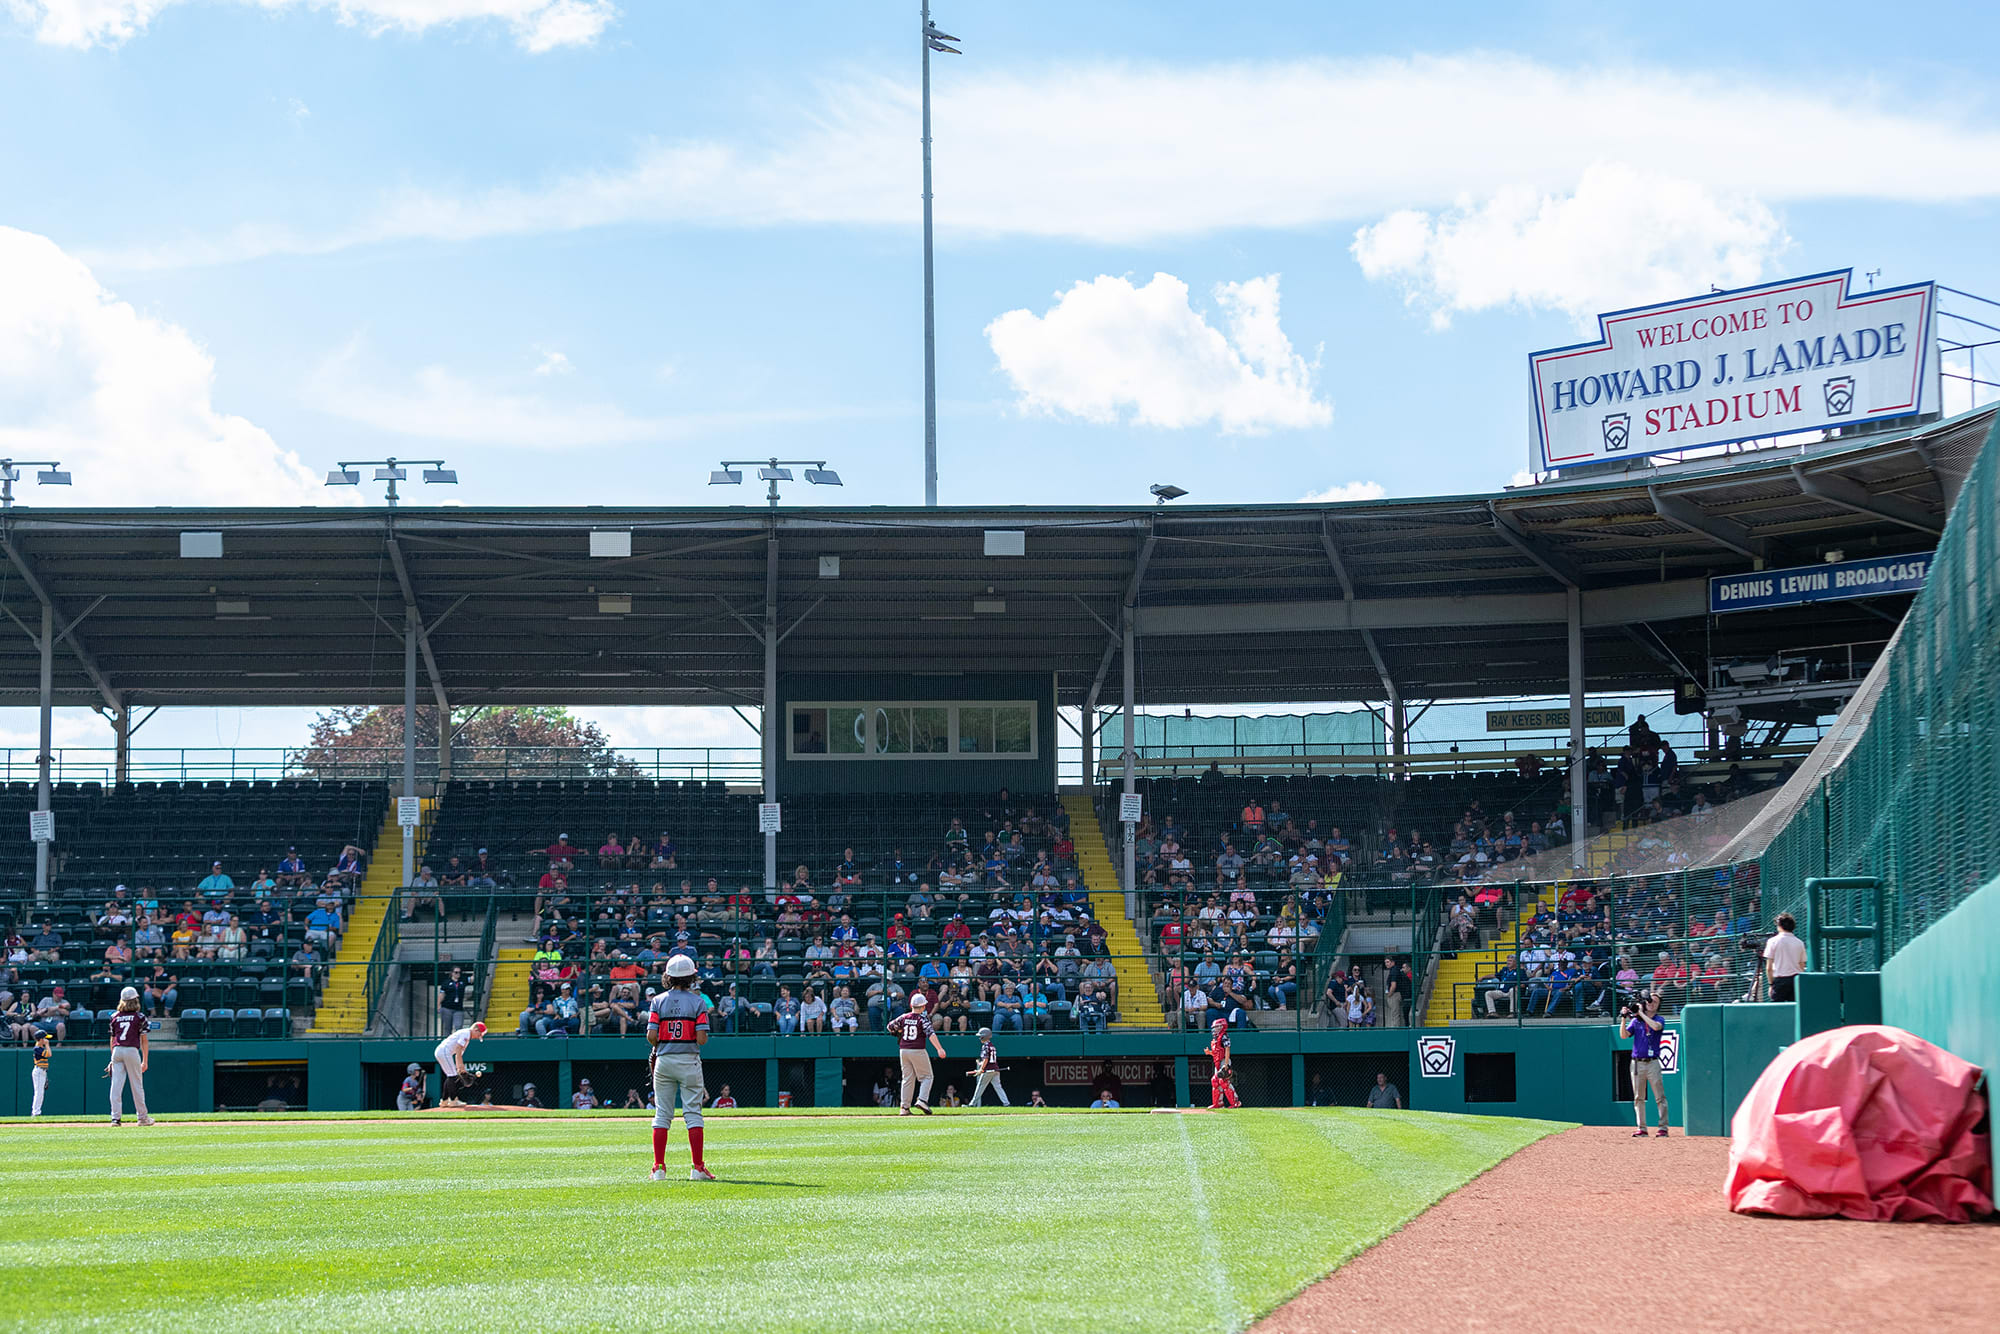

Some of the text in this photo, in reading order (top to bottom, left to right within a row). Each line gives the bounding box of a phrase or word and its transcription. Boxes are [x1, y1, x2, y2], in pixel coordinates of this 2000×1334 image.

[1637, 299, 1814, 349] WELCOME TO
[1551, 323, 1907, 411] HOWARD J. LAMADE
[1645, 385, 1802, 436] STADIUM
[1720, 561, 1926, 601] DENNIS LEWIN BROADCAST
[1491, 711, 1620, 727] RAY KEYES PRES ECTION
[119, 1021, 130, 1040] 7
[668, 1020, 683, 1039] 48
[902, 1025, 917, 1041] 19
[1049, 1065, 1088, 1080] PUTSEE
[1091, 1065, 1141, 1080] VANUCCI
